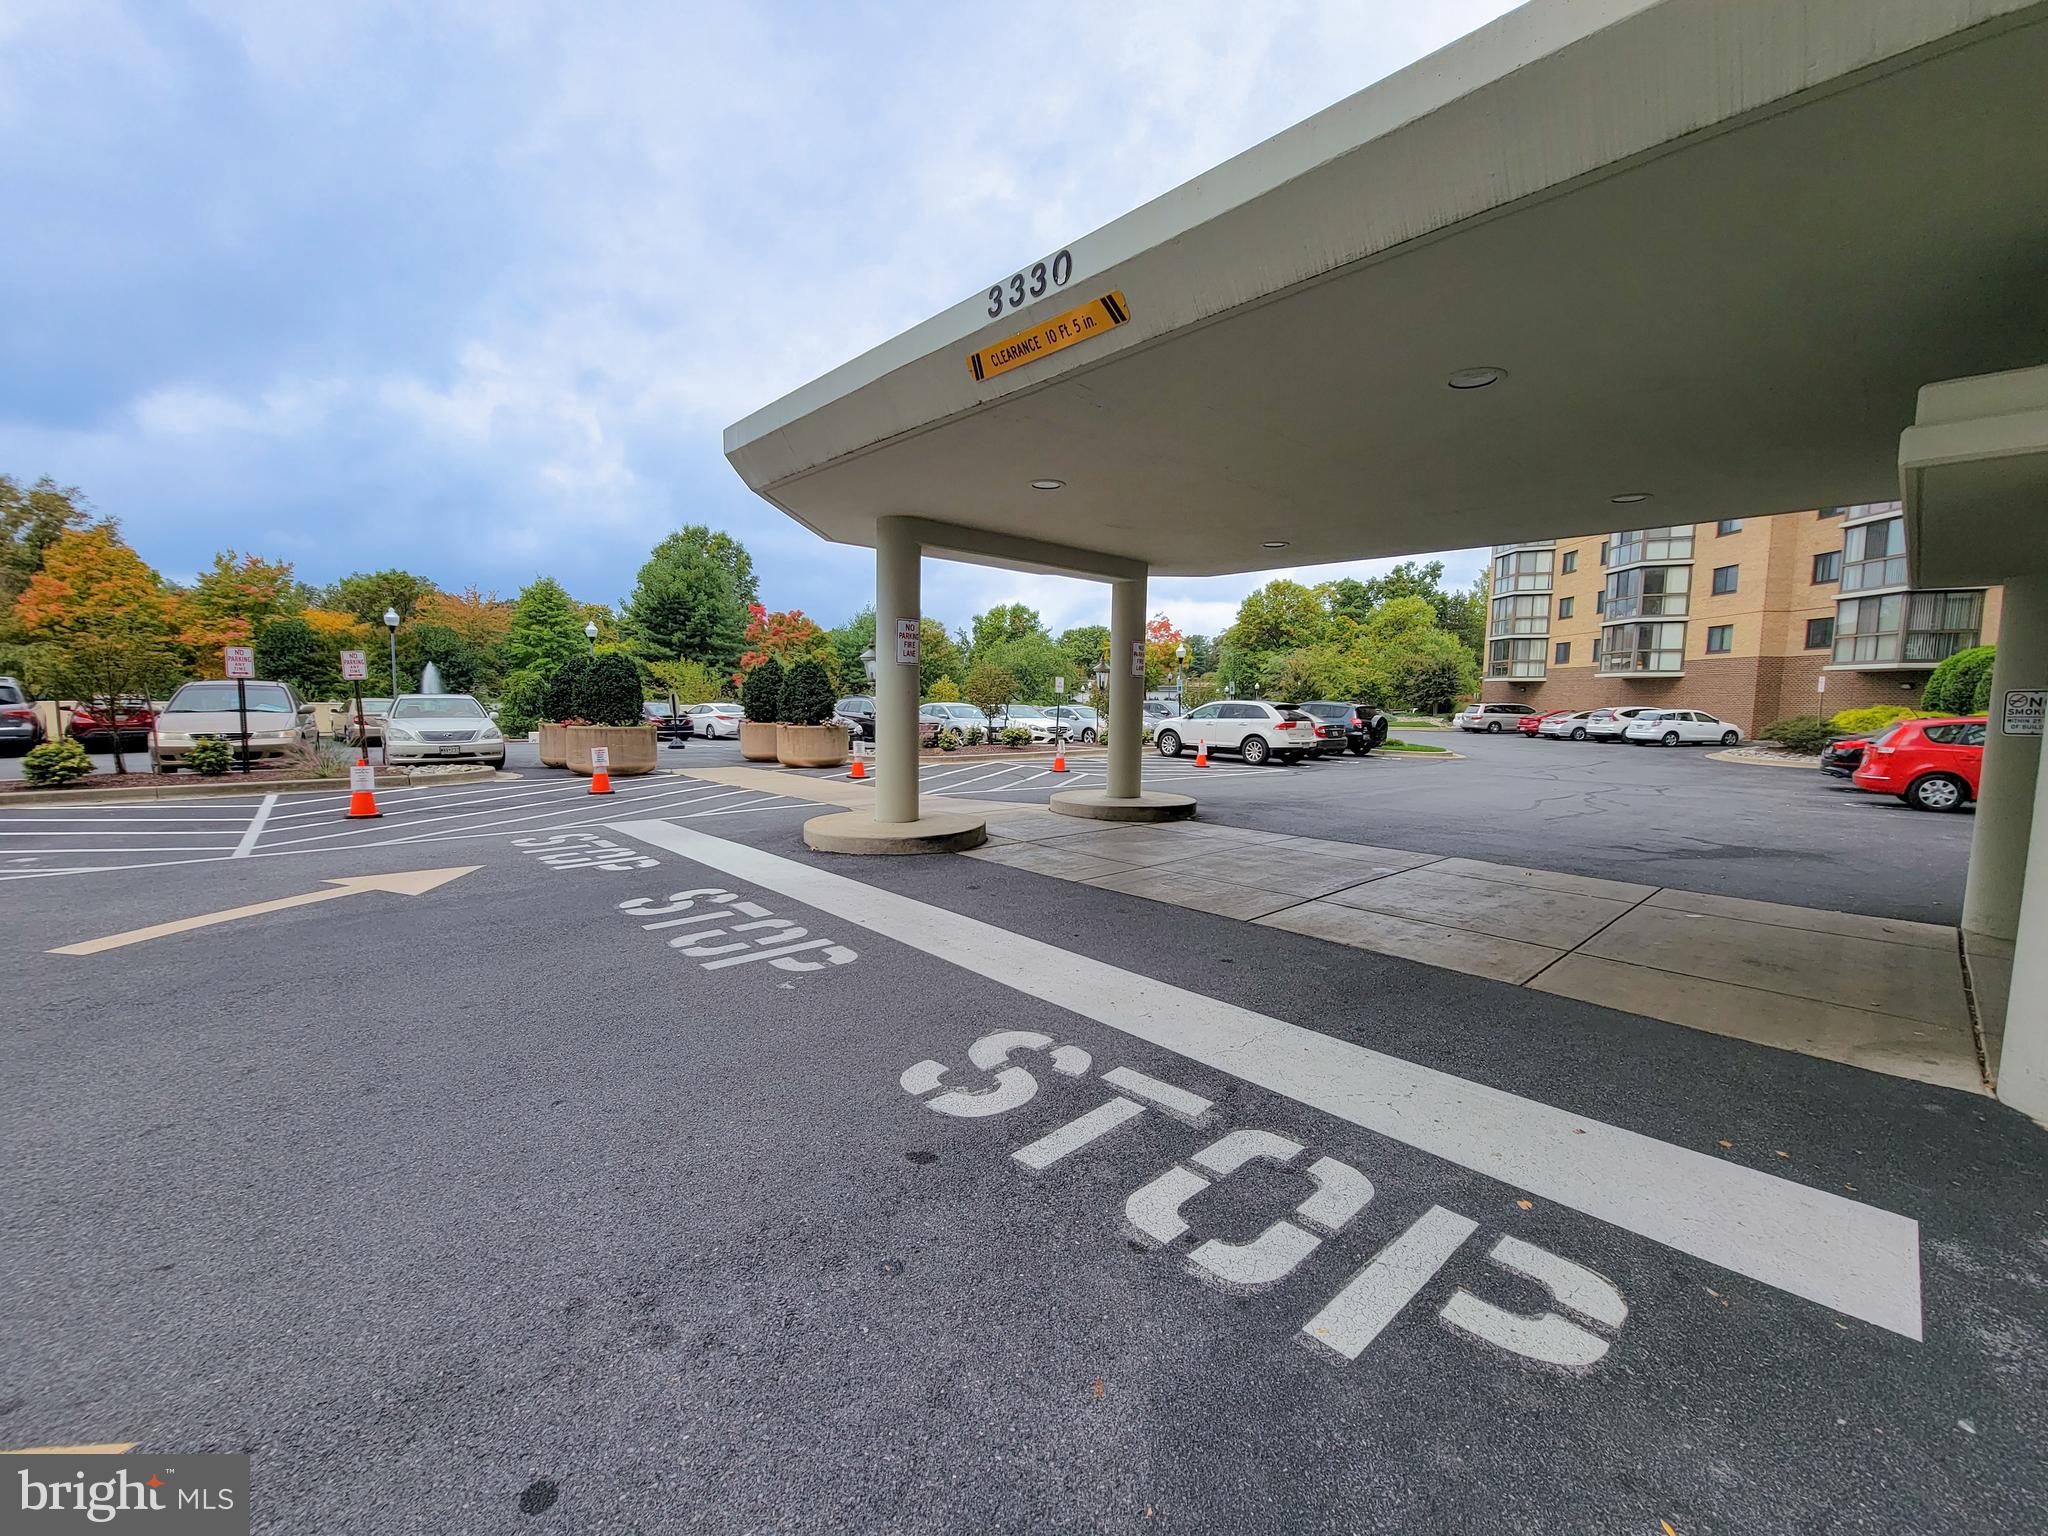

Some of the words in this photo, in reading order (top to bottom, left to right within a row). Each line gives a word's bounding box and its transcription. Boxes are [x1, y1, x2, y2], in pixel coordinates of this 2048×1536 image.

[988, 250, 1072, 318] 3330
[990, 336, 1042, 367] CLEARANCE
[1045, 329, 1057, 344] 10
[1072, 318, 1081, 333] 5
[1081, 315, 1097, 330] in.
[899, 632, 919, 640] PARKING
[511, 833, 660, 871] STOP
[619, 888, 858, 972] STOP
[900, 1031, 1628, 1367] STOP
